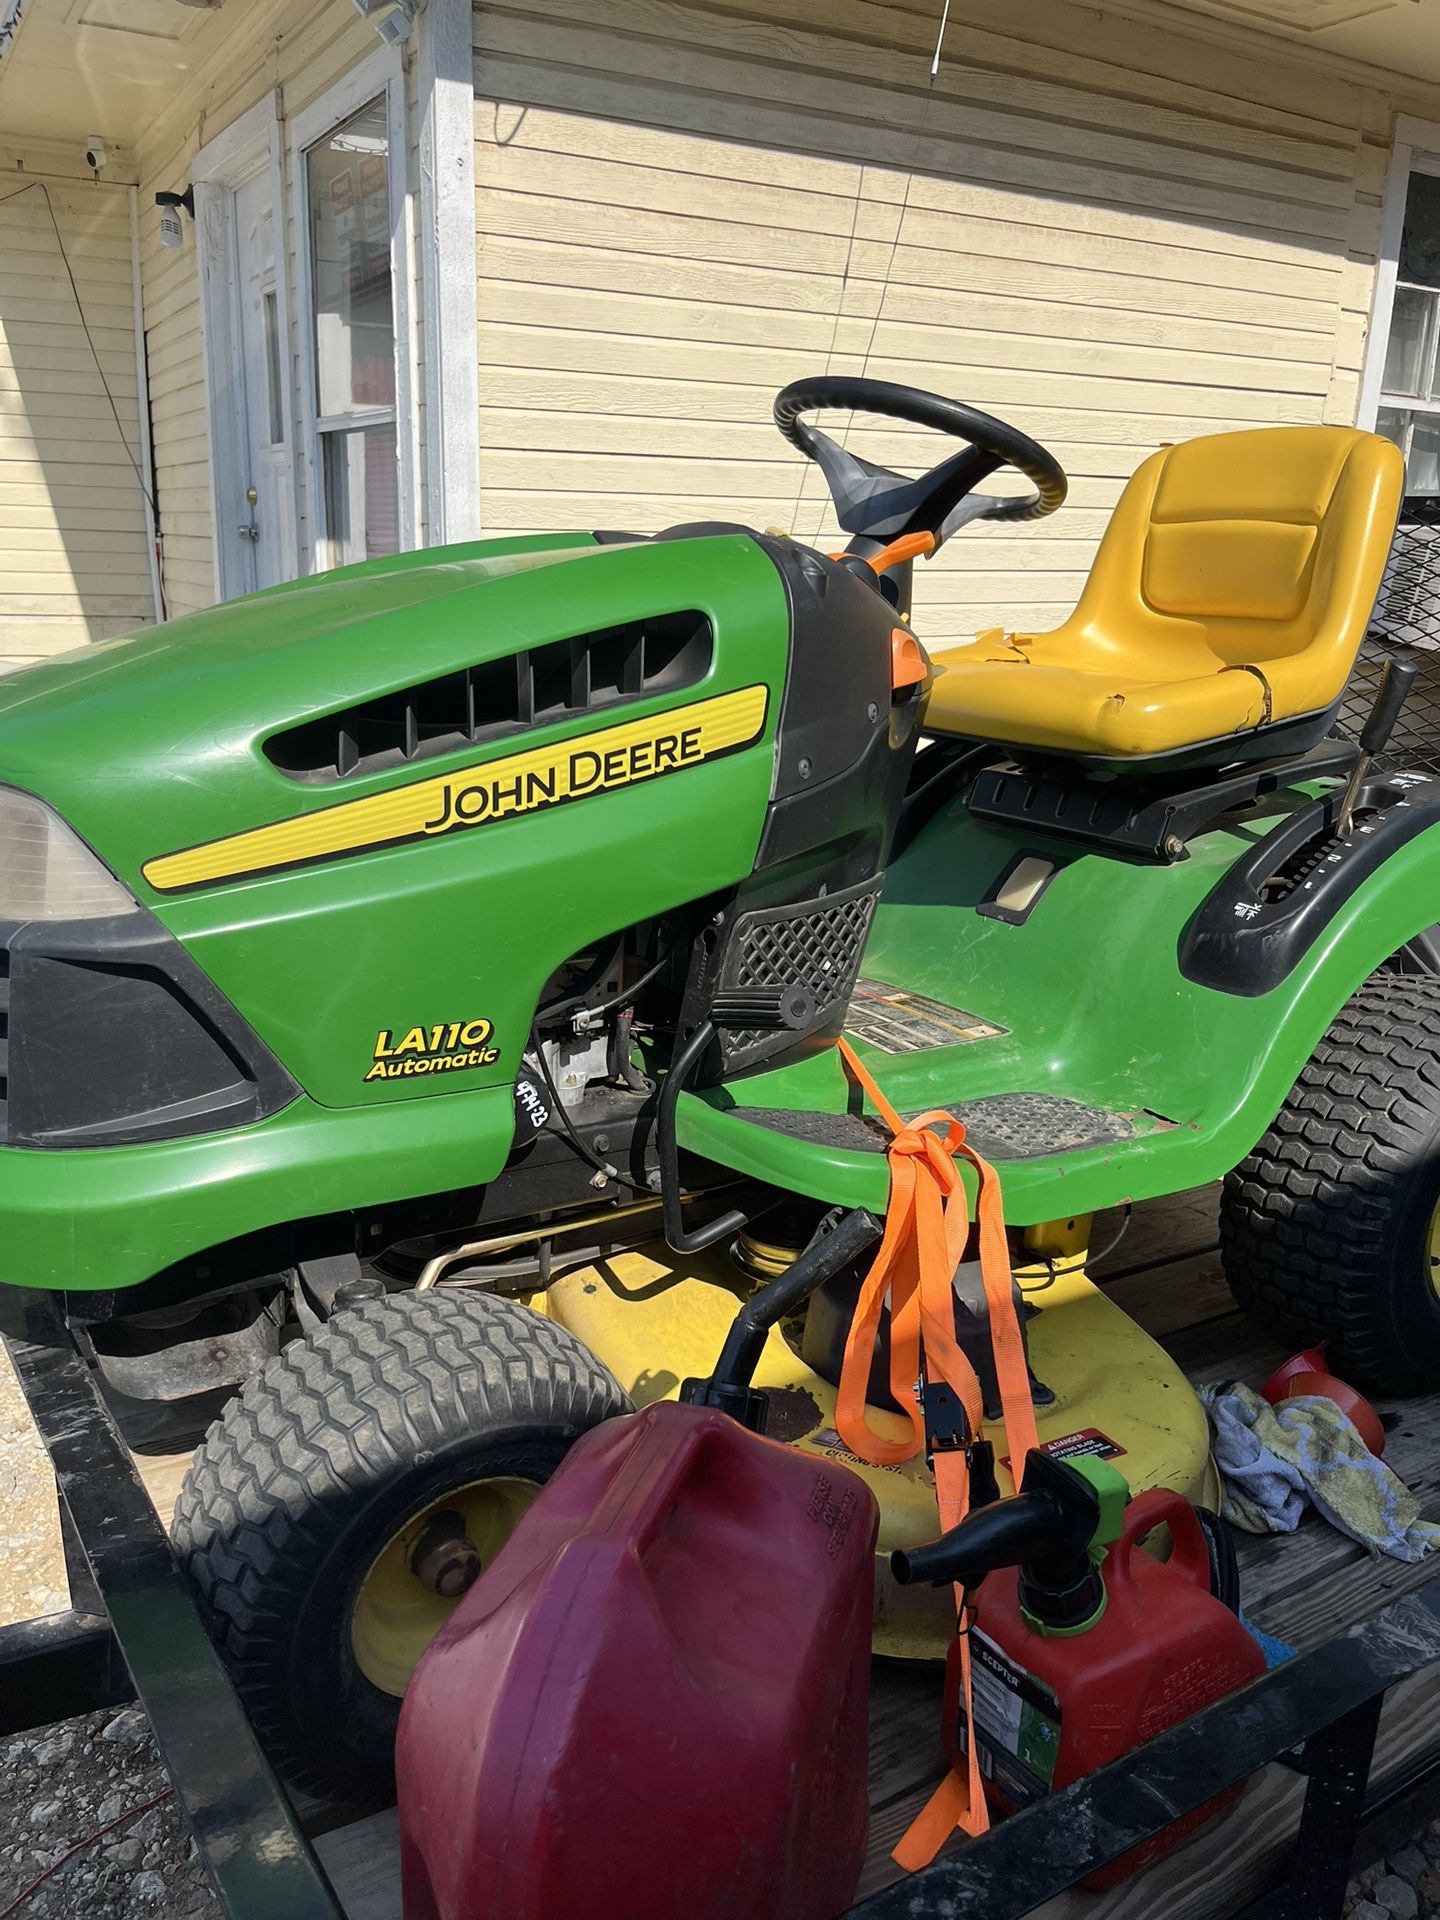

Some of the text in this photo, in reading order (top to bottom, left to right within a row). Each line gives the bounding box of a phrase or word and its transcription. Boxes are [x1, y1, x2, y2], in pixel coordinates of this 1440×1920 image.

[424, 726, 703, 830] JOHN DEERE
[373, 1018, 492, 1058] LA110
[365, 1047, 498, 1080] Automatic
[1055, 1433, 1085, 1448] DANGER
[982, 1651, 1019, 1687] SCEPTER
